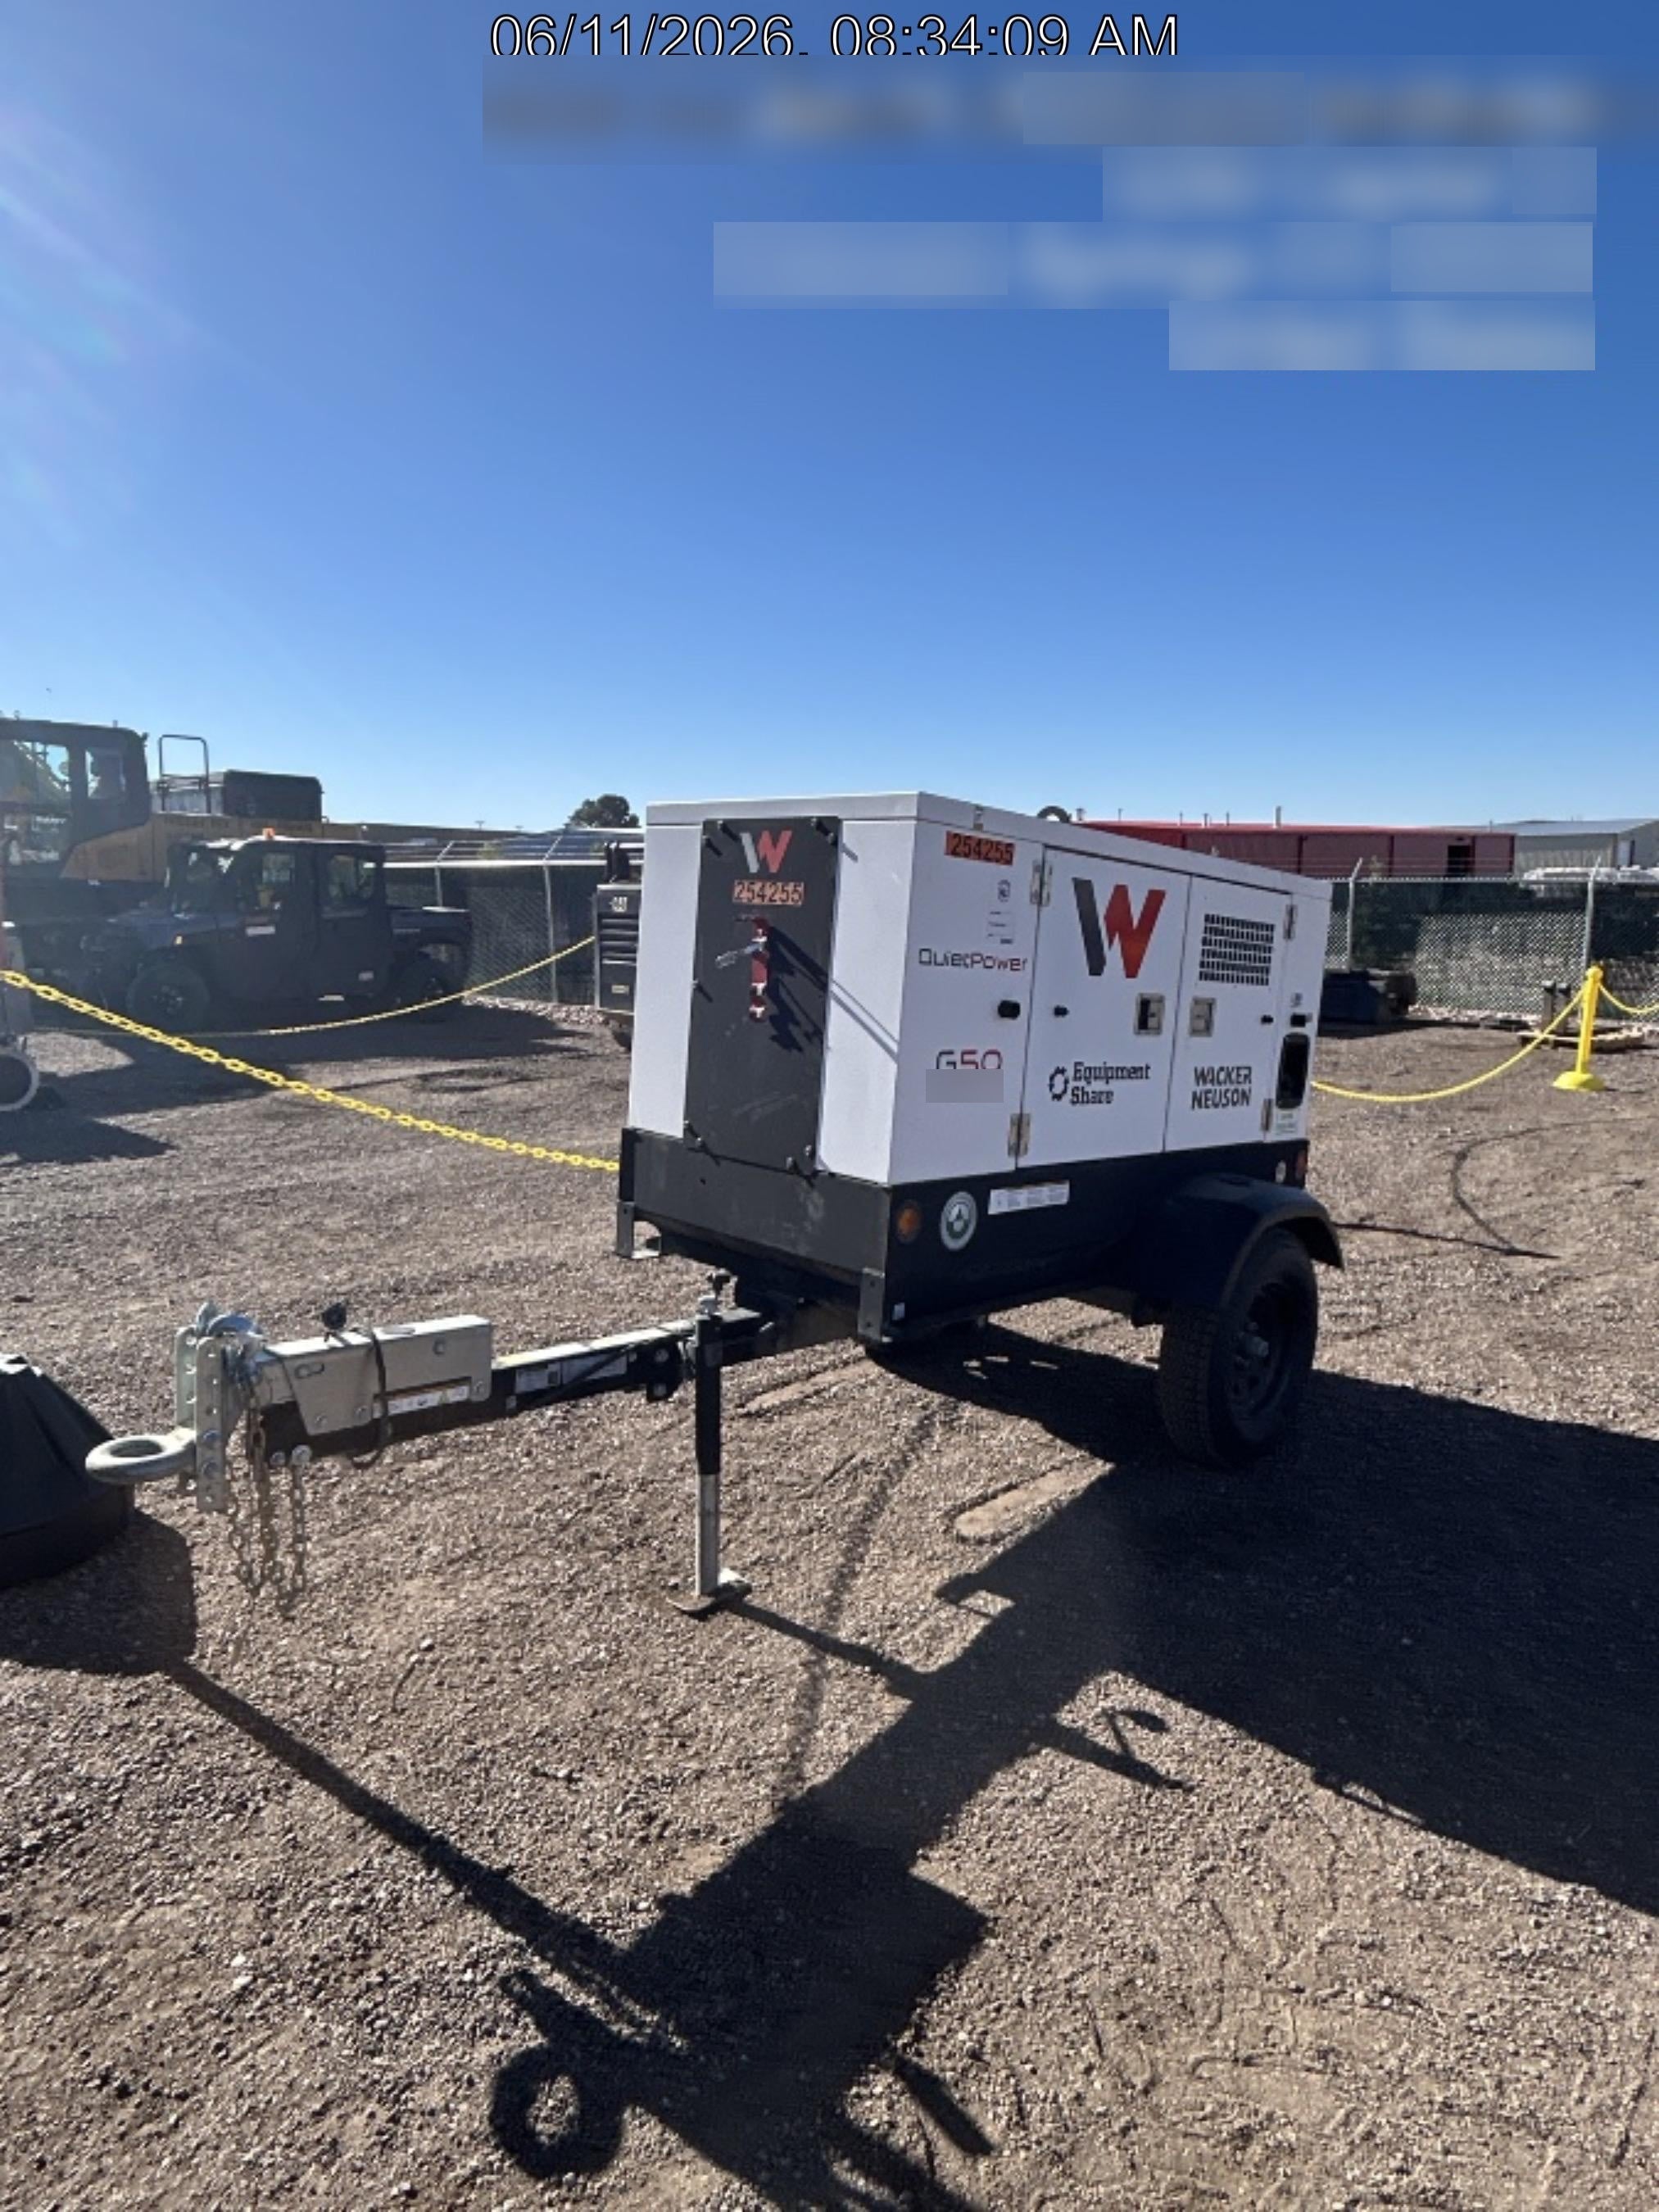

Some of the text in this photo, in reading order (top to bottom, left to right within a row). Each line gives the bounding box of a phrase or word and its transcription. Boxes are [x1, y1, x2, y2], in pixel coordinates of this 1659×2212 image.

[951, 833, 1013, 864] 254255
[735, 882, 802, 903] 254255
[918, 948, 1027, 972] QuietPower
[1072, 1061, 1151, 1085] Equipment
[1194, 1066, 1252, 1086] WACKER
[1070, 1086, 1114, 1105] Share
[1191, 1087, 1252, 1110] NEUSON
